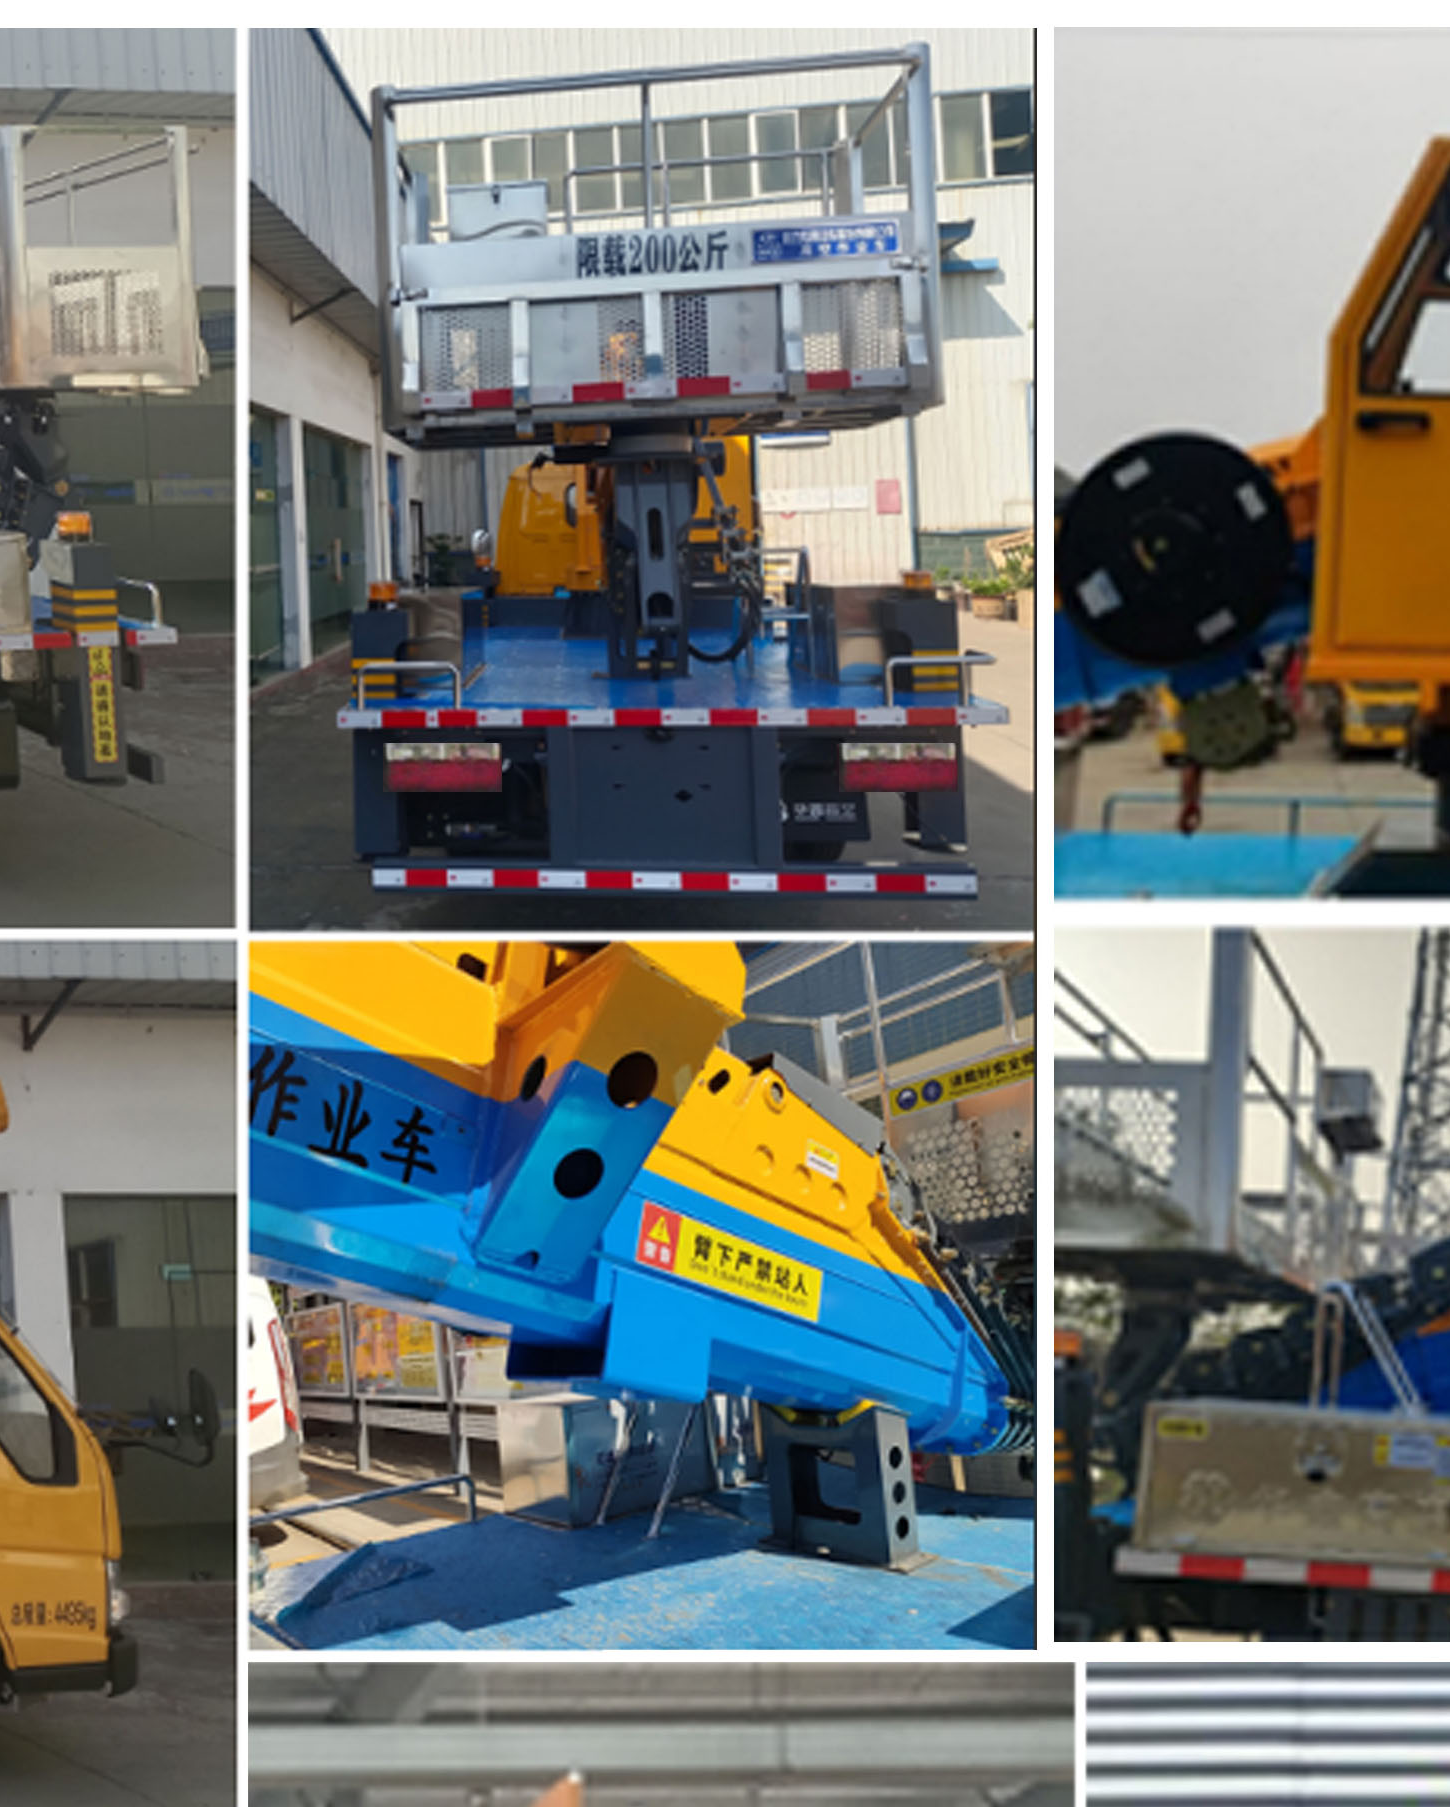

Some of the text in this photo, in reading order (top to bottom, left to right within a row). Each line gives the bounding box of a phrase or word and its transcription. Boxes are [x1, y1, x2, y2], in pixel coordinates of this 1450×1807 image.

[576, 230, 729, 277] 限载200公斤
[694, 1234, 808, 1297] 臂下严禁站人
